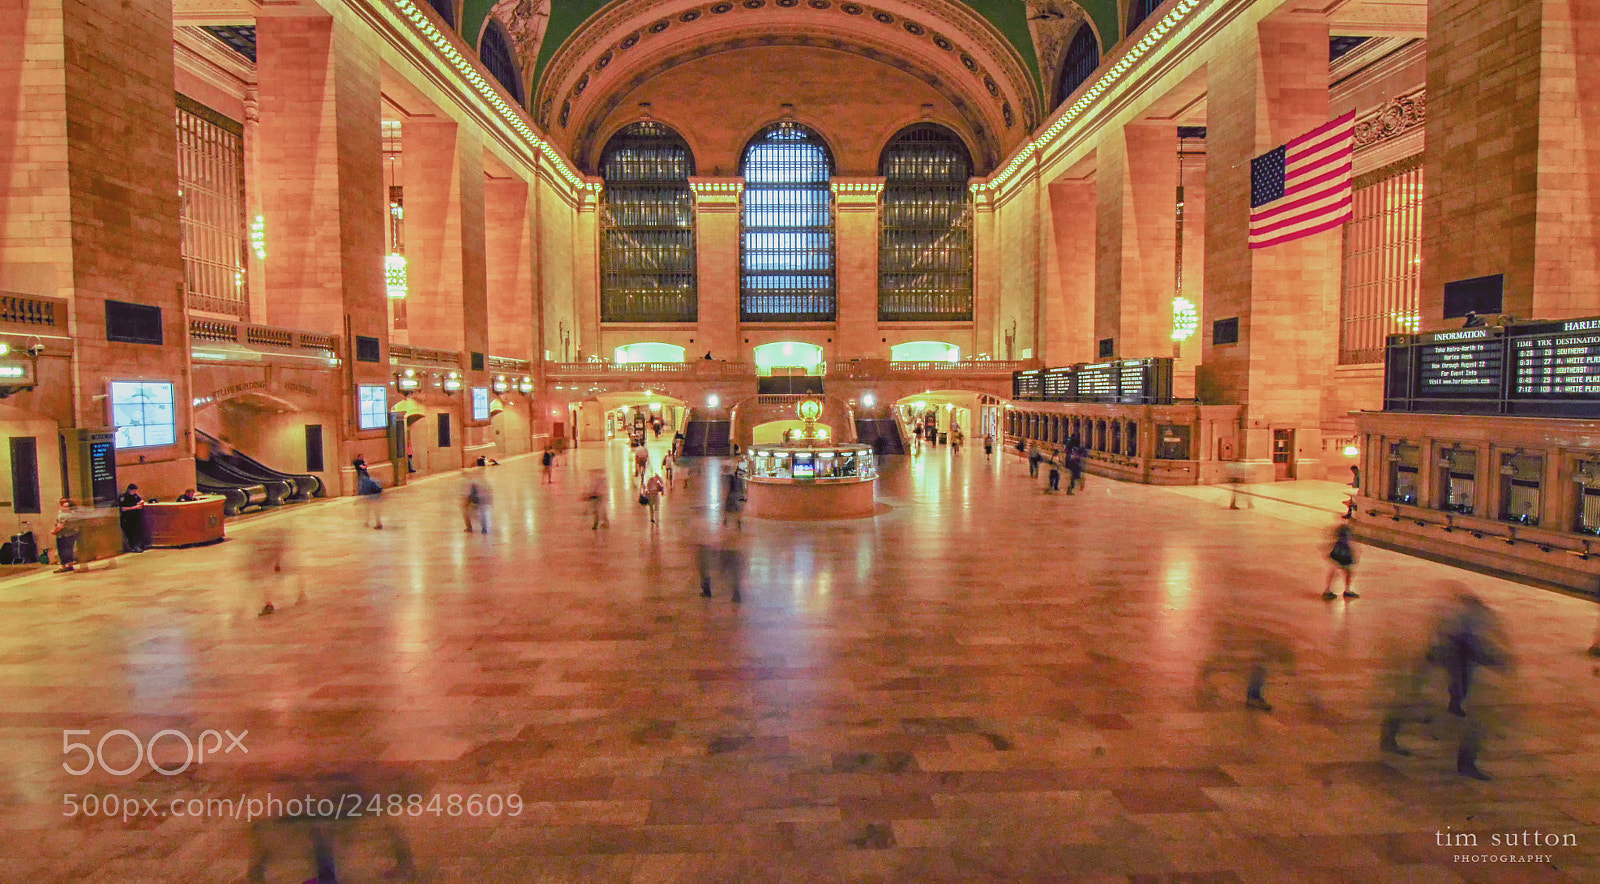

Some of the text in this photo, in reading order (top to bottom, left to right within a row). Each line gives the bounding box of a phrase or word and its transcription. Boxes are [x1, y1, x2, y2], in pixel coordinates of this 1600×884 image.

[1434, 330, 1487, 341] INFORMATION
[1537, 339, 1552, 347] TRK
[1556, 347, 1588, 355] SOUTHEAST
[1555, 366, 1588, 374] SOUTHEAST
